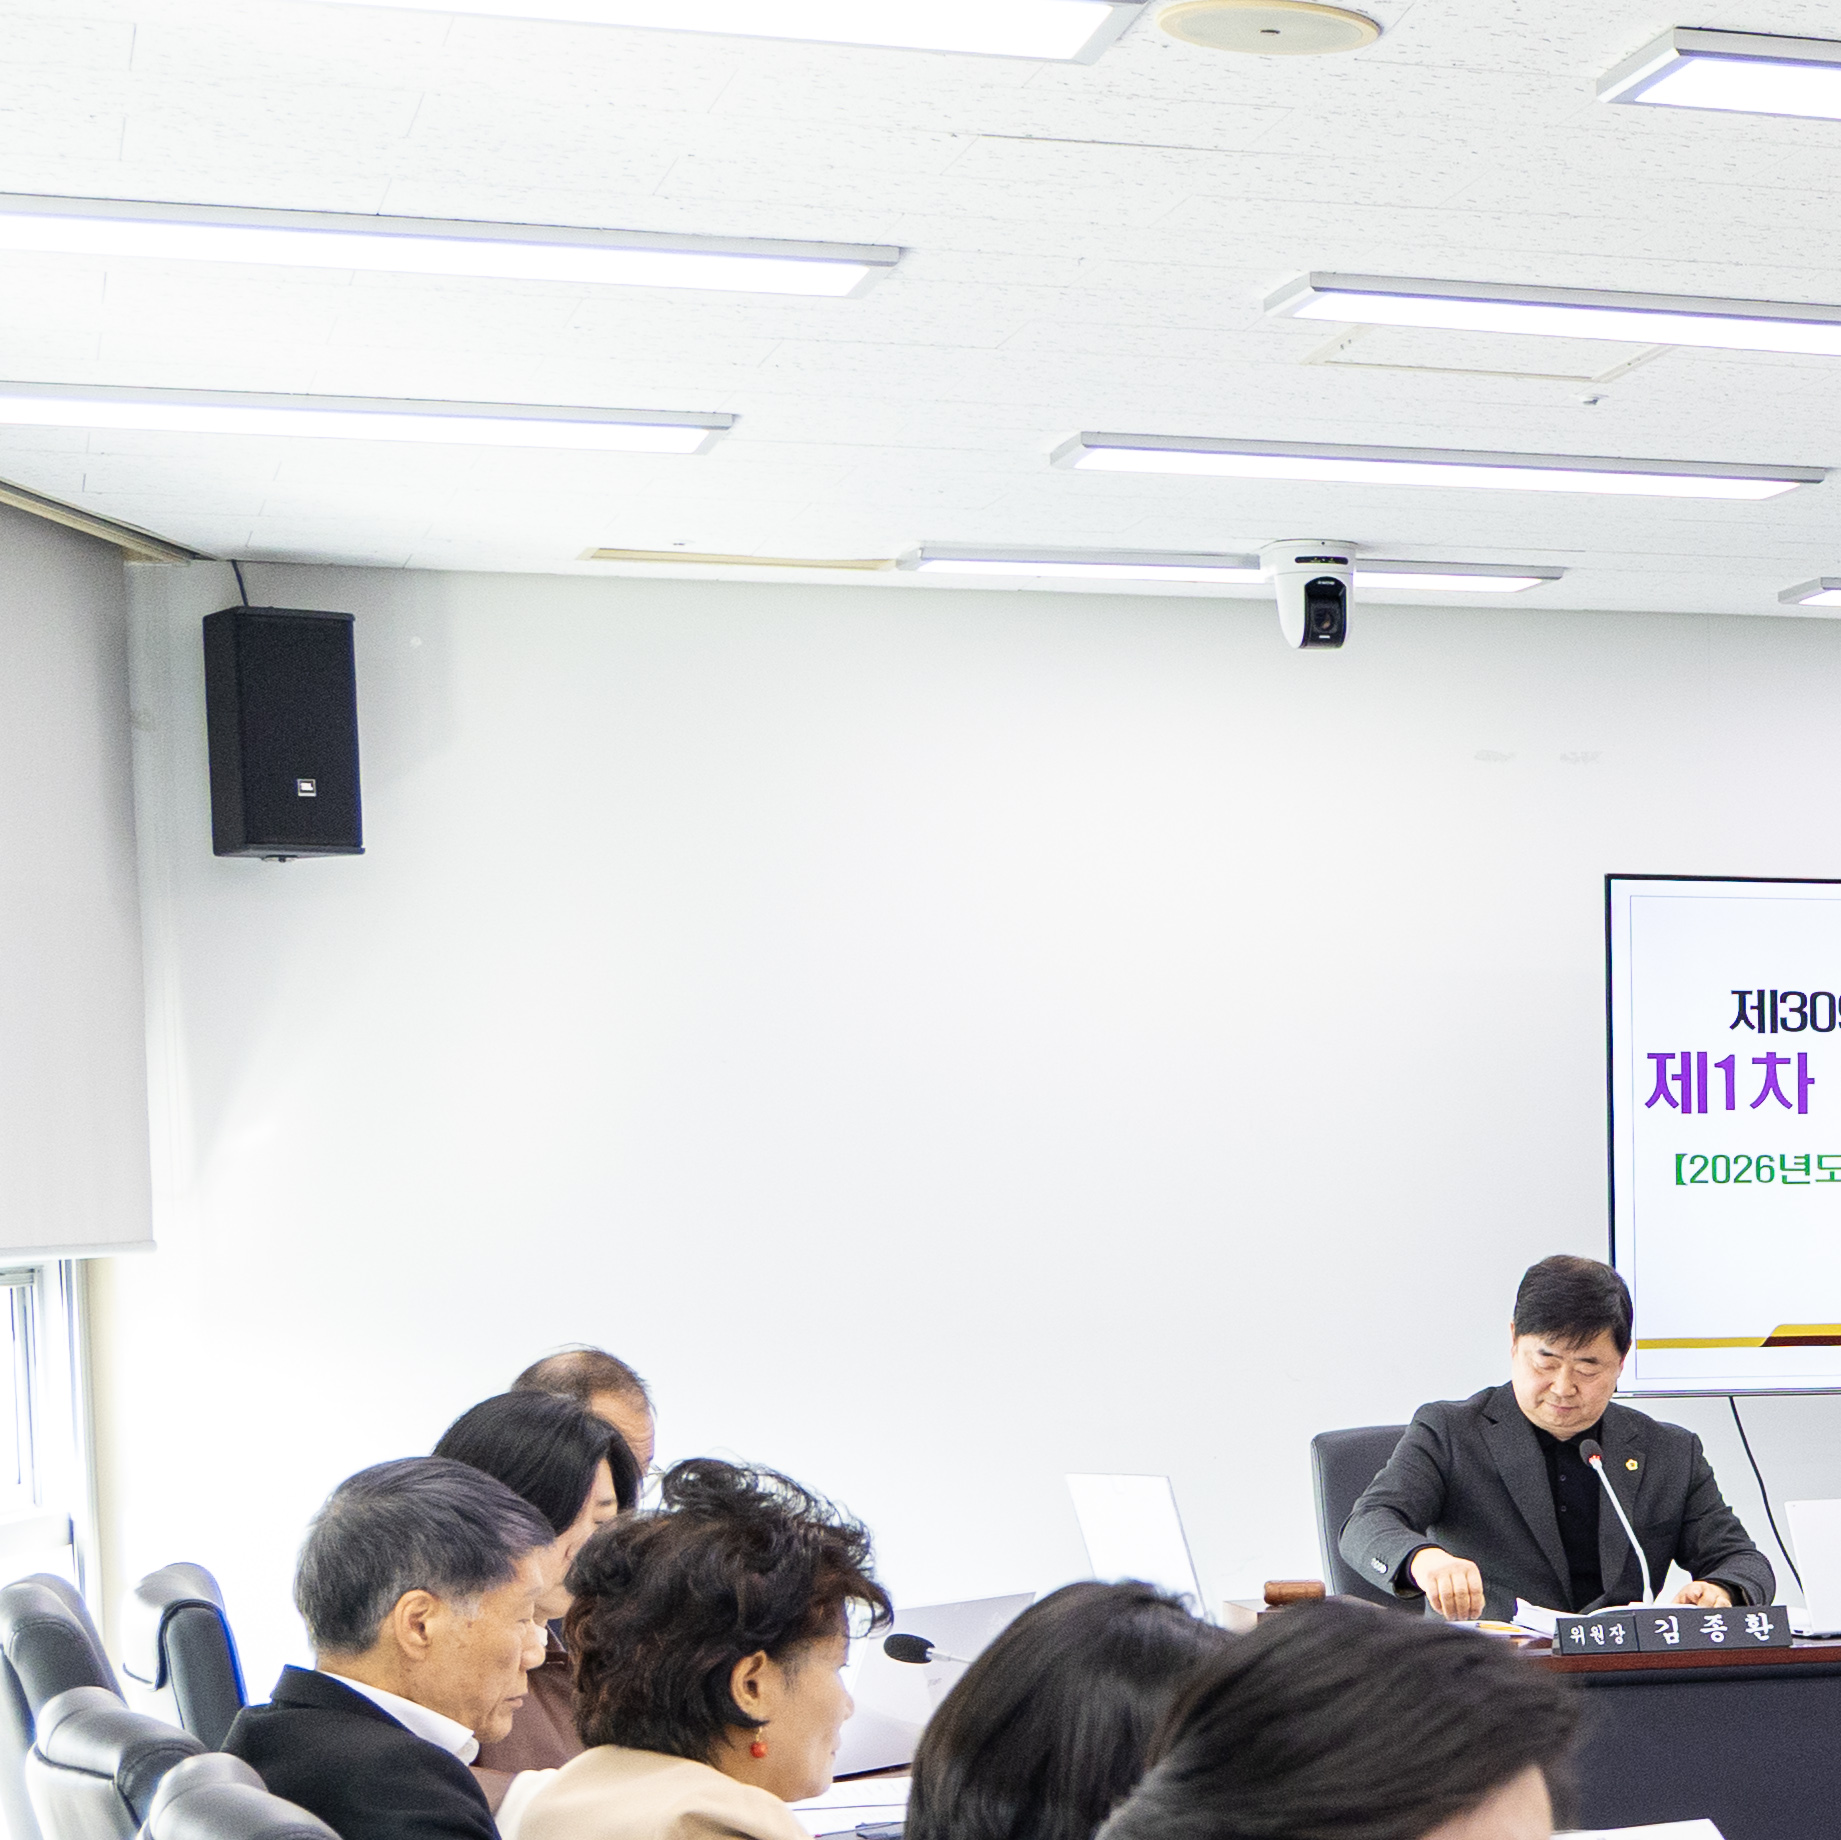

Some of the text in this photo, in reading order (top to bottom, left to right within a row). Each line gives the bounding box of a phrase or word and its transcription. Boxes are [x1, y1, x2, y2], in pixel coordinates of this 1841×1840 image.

[1644, 1051, 1816, 1115] 제1차
[1569, 1612, 1775, 1646] 위원장 김종환
